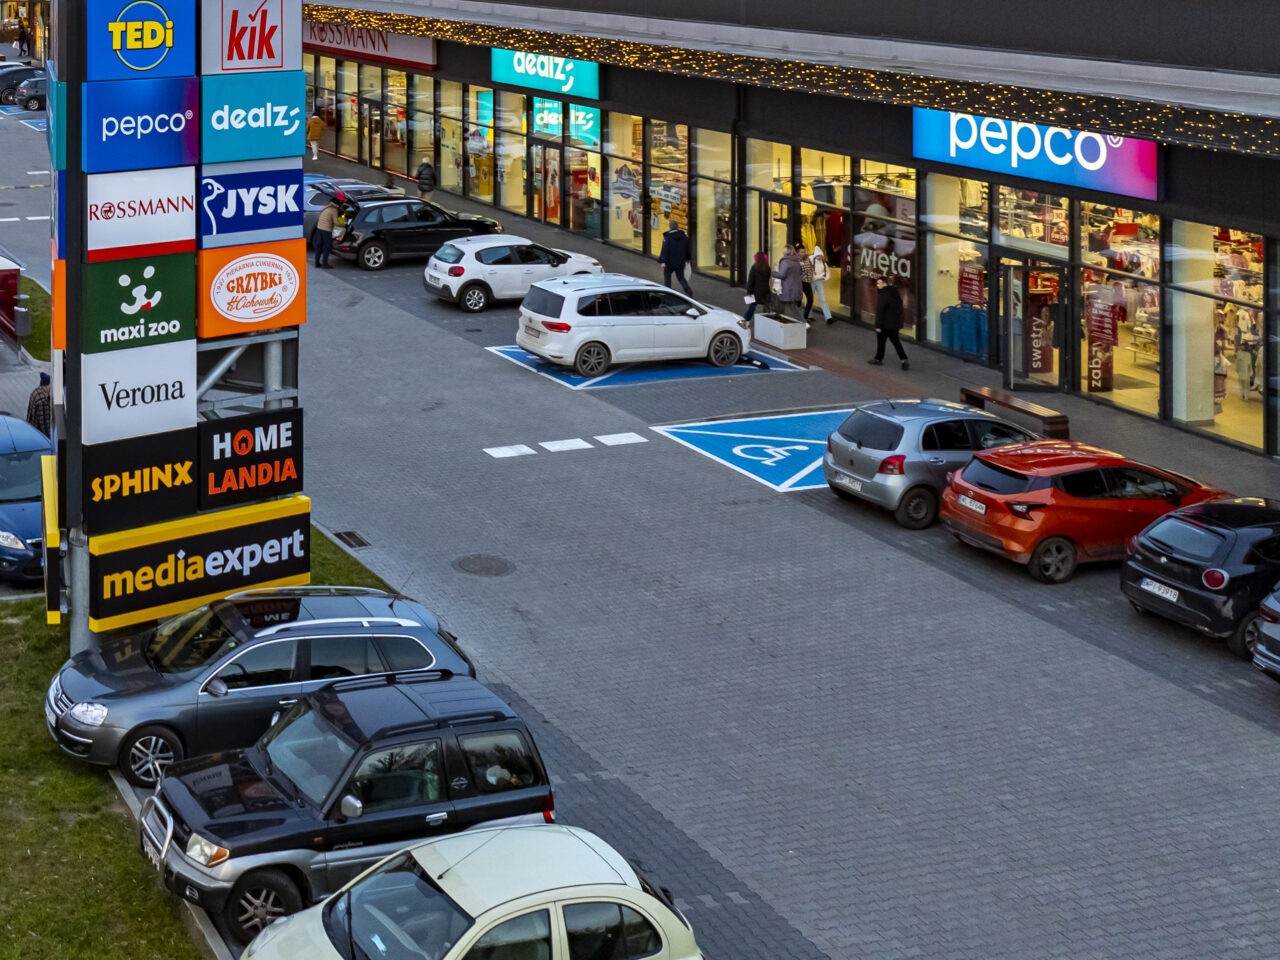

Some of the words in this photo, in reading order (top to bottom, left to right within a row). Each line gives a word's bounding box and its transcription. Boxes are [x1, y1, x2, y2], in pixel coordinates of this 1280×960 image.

[107, 19, 174, 51] TEDi
[226, 0, 279, 61] kik
[309, 21, 389, 53] ROSSMANN
[102, 112, 186, 142] pepco
[210, 102, 289, 131] dealz
[949, 111, 1108, 171] pepco
[89, 194, 195, 222] ROSSMANN
[221, 183, 301, 219] JYSK
[99, 318, 146, 344] maxi
[148, 319, 181, 336] zoo
[1031, 316, 1044, 369] swetry
[98, 379, 186, 412] Verona
[212, 421, 294, 461] HOME
[91, 460, 194, 503] SPHINX
[207, 457, 298, 496] LANDIA
[102, 528, 305, 601] mediaexpert
